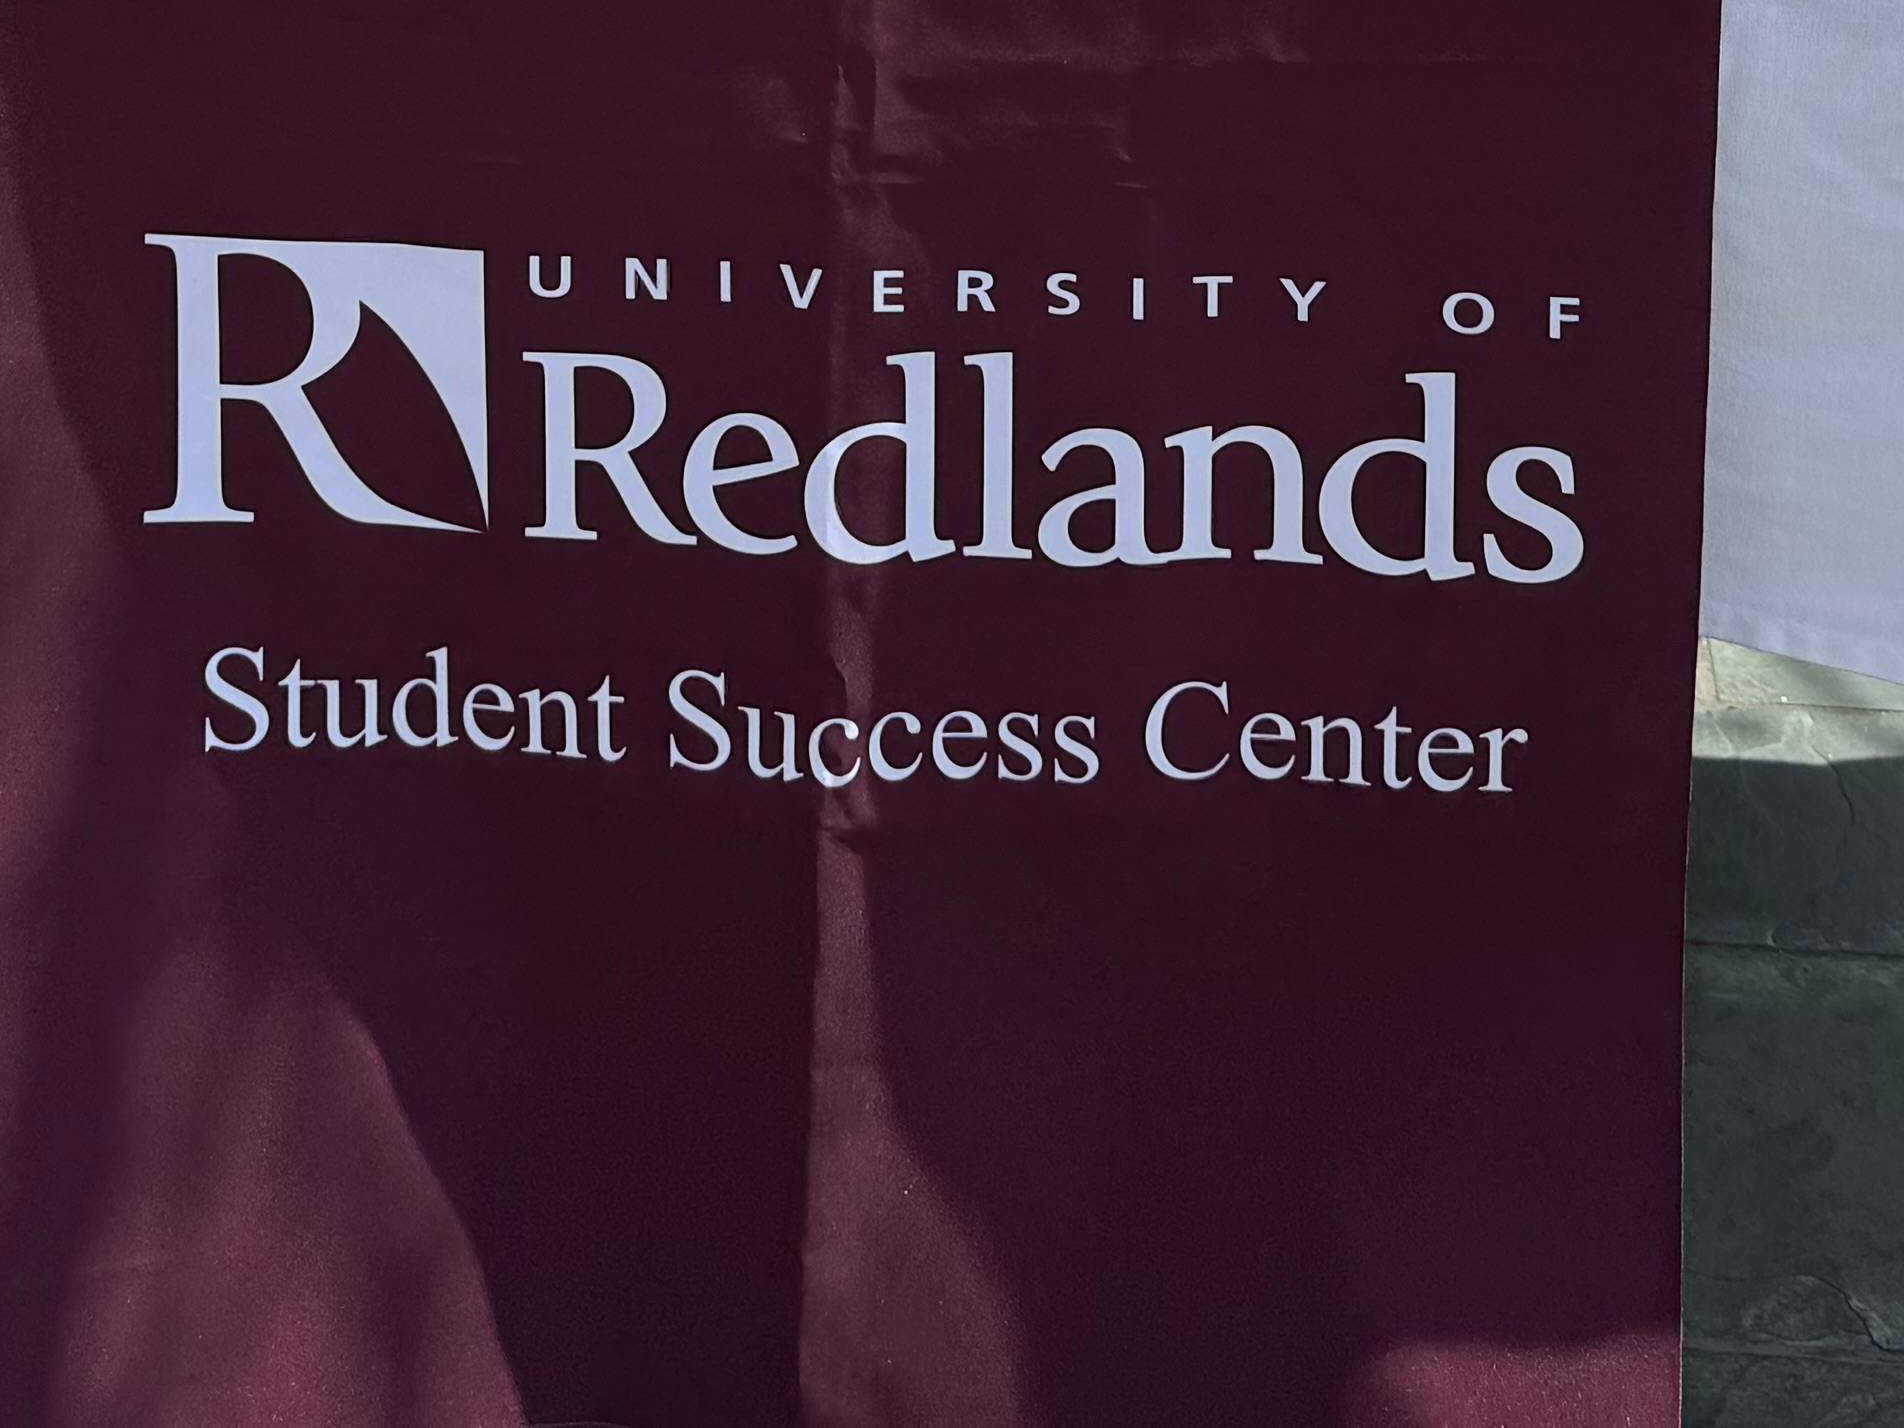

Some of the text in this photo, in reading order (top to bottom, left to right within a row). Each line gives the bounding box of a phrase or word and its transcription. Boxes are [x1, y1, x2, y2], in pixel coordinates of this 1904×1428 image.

[526, 255, 1585, 341] UNIVERSITY OF
[521, 350, 1586, 584] Redlands
[204, 646, 1530, 794] Student Success Center
